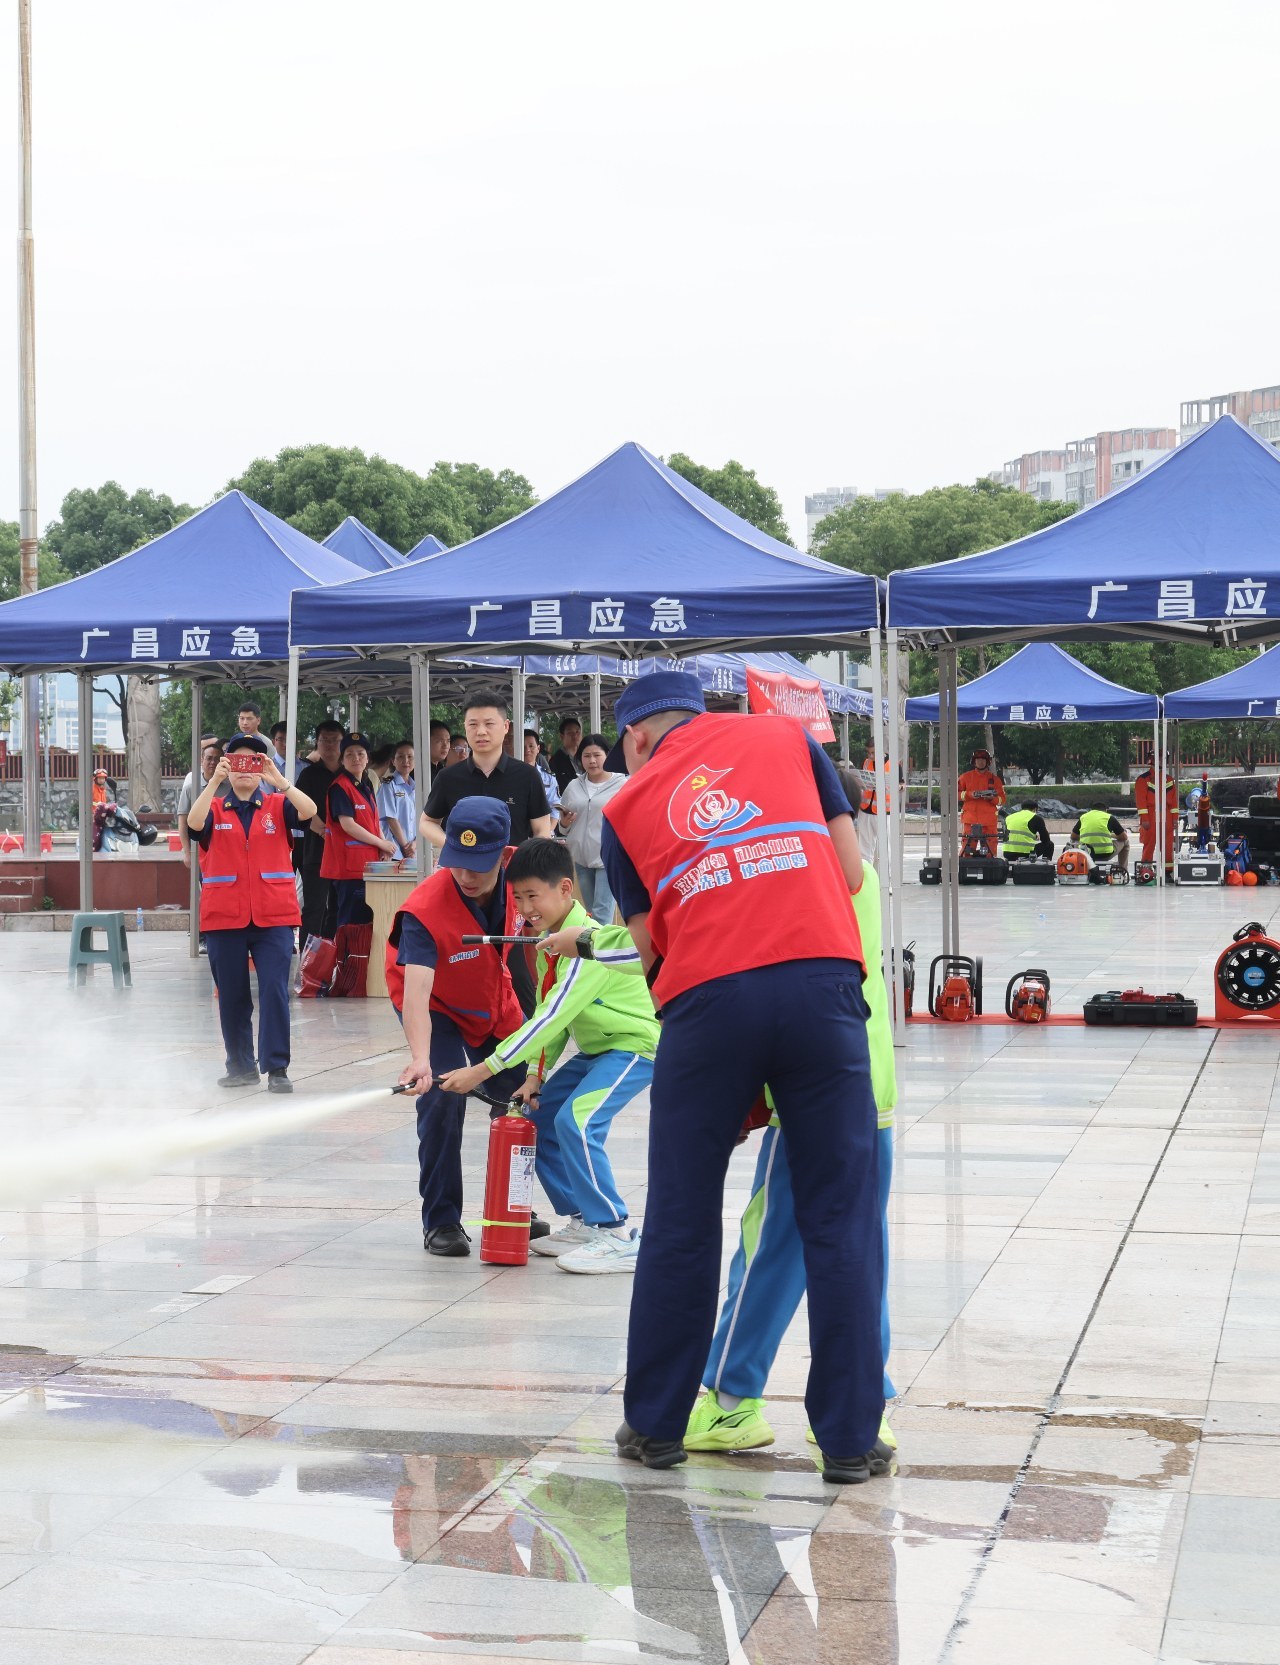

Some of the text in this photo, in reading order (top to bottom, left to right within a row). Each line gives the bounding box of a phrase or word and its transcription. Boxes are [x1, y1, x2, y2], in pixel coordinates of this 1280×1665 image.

[466, 596, 688, 638] 广昌应急
[1086, 577, 1268, 620] 广昌应
[79, 625, 262, 659] 广昌应急
[982, 704, 1079, 721] 广昌应急
